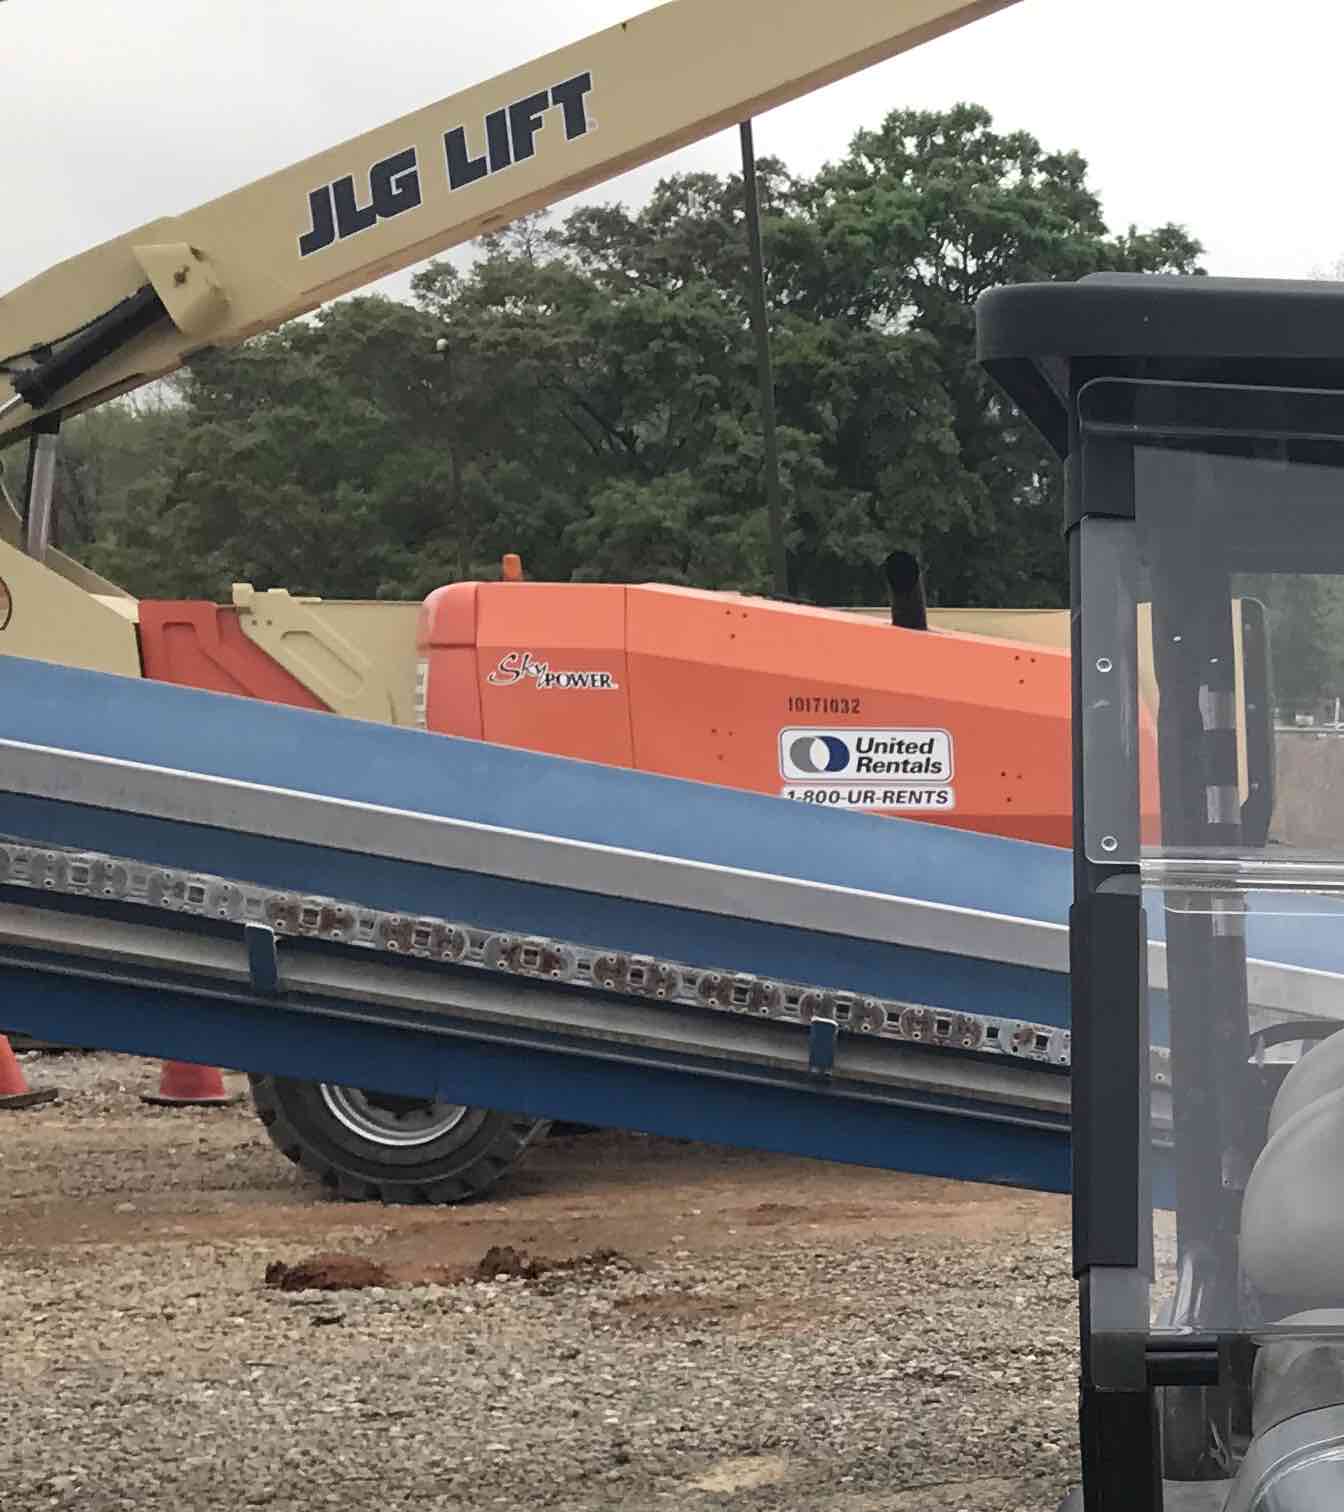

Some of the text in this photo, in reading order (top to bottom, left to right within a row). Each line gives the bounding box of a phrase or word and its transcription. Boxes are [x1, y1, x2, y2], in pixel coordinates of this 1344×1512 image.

[298, 70, 592, 258] JLG LIFT
[856, 737, 935, 755] United
[856, 757, 942, 774] Rentals
[788, 790, 949, 805] 1-800-UR-RENTS
